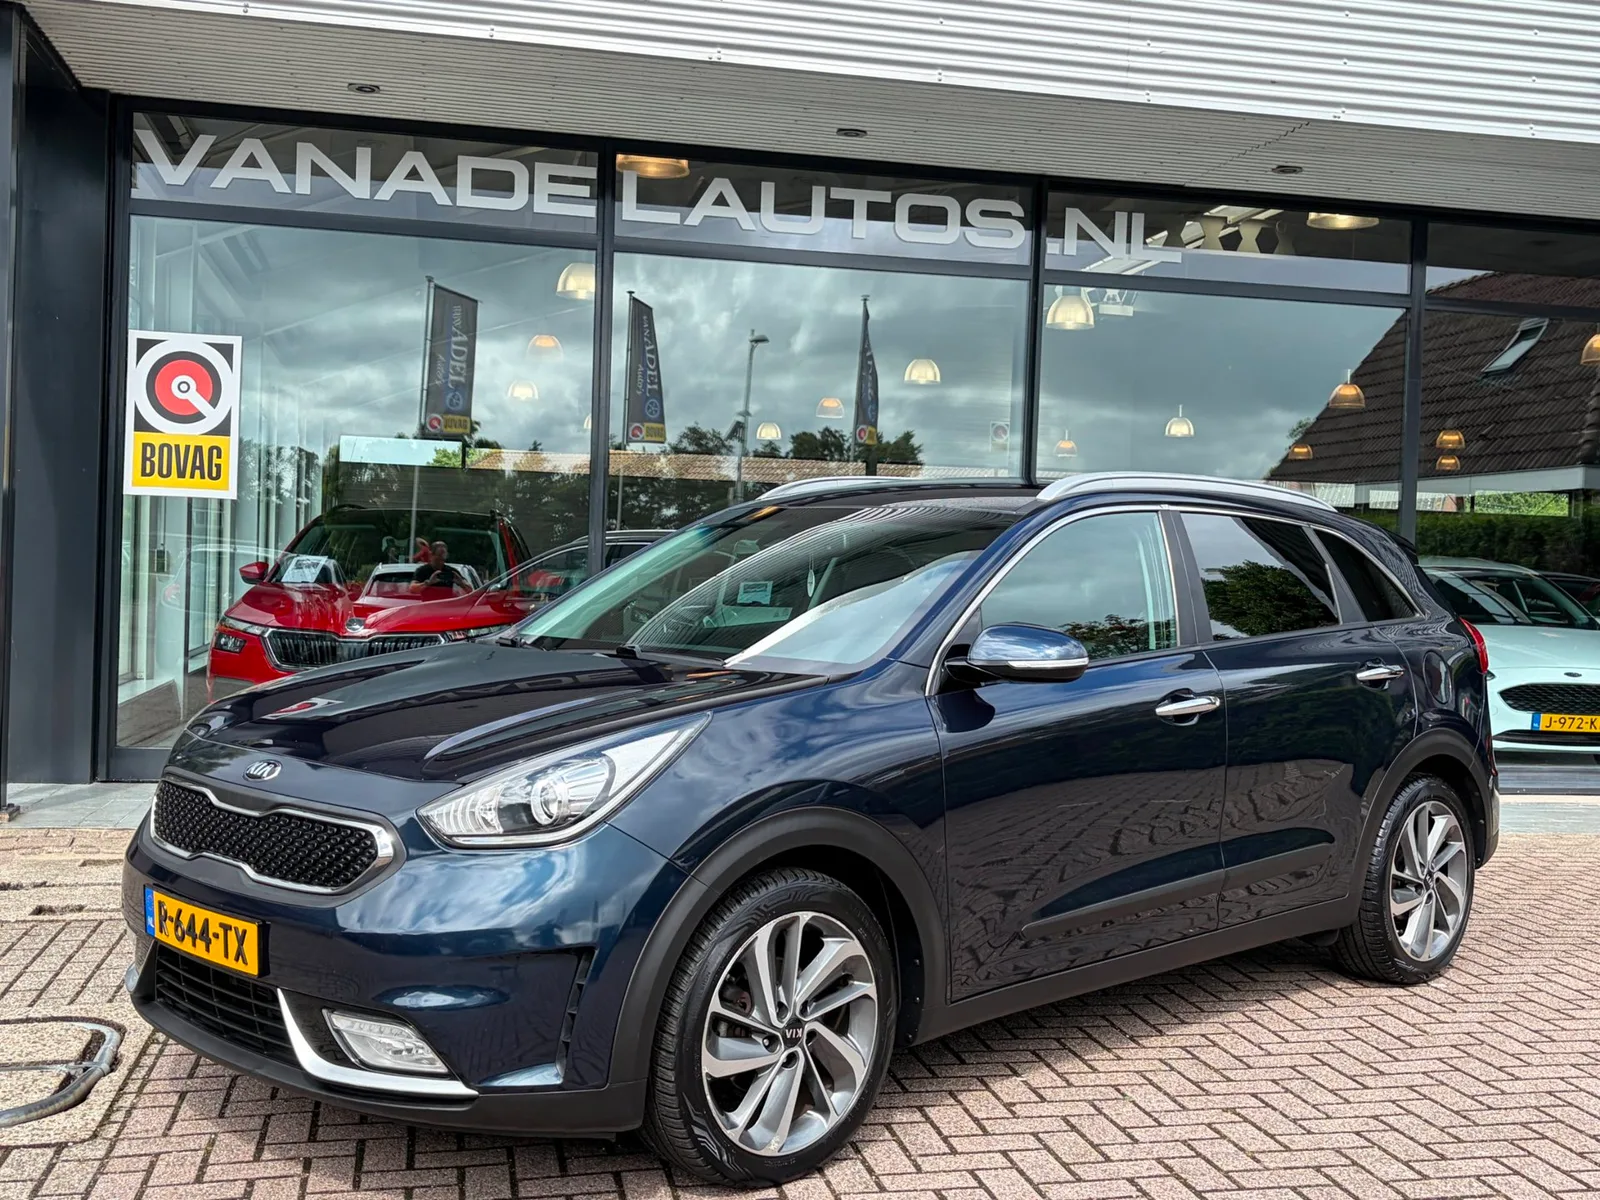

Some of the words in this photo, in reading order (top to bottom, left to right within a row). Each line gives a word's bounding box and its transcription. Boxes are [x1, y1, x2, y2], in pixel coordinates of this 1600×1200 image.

[140, 442, 222, 481] BOVAG
[1545, 716, 1600, 730] J-972-K
[246, 761, 275, 777] KIA
[157, 899, 248, 966] R-644-TX
[785, 1028, 803, 1039] KIA
